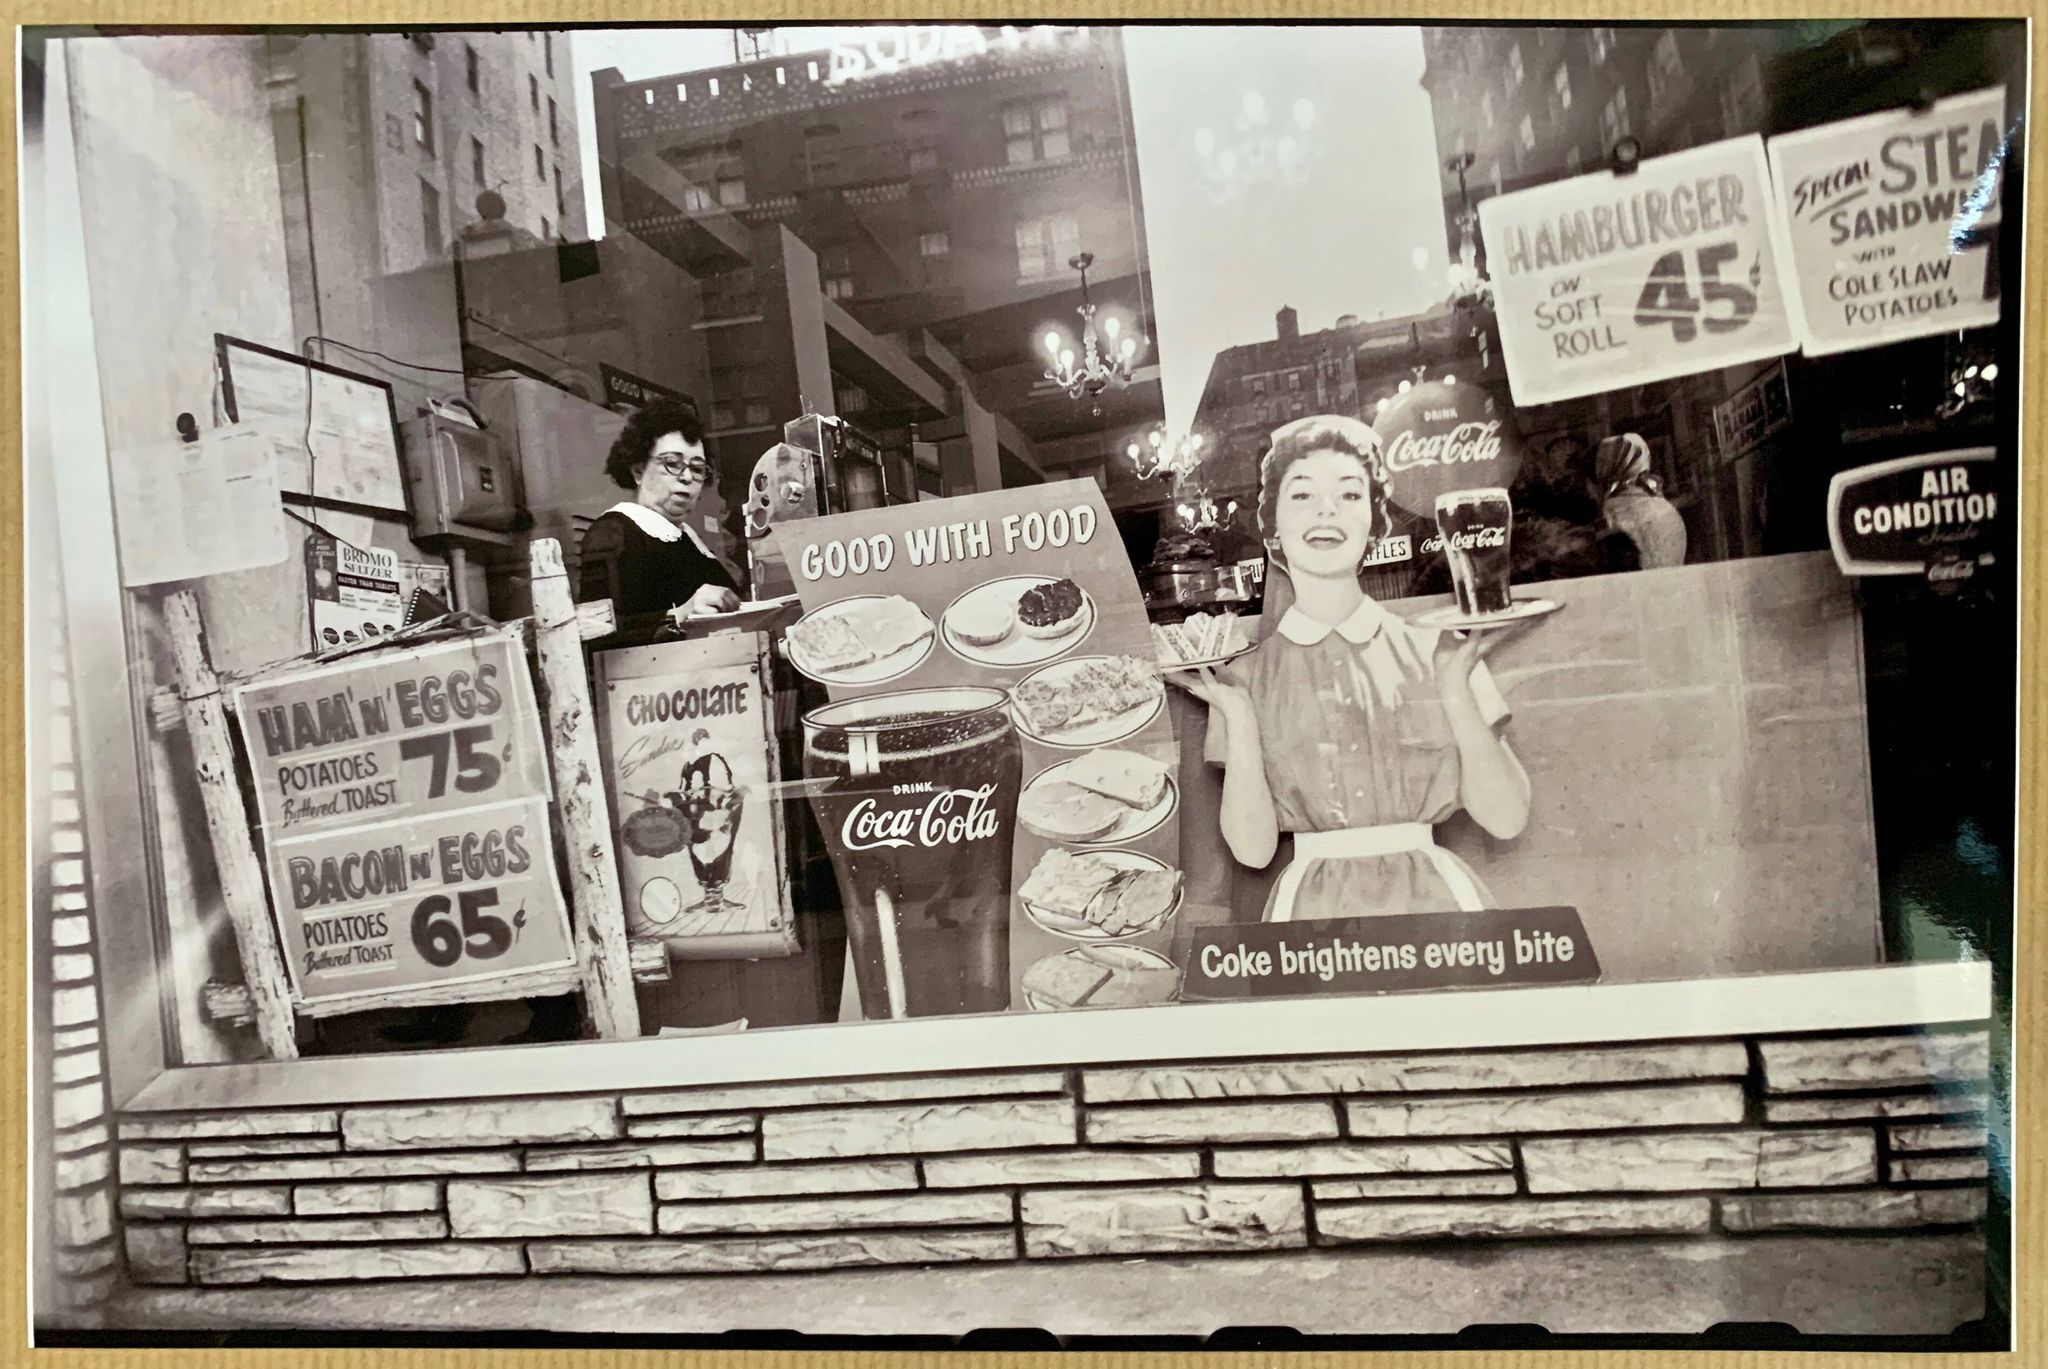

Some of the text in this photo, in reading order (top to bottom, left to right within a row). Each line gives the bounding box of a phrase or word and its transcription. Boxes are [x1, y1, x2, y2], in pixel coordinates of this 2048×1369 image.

[1503, 173, 1749, 276] HAMBURGER
[1854, 245, 1896, 265] WITH
[1550, 276, 1581, 299] ON
[1534, 294, 1602, 331] SOFT
[1844, 287, 1958, 327] POTATOES
[1553, 325, 1627, 359] ROLL
[610, 376, 640, 398] GOOD
[1423, 408, 1458, 422] DRINK
[1386, 419, 1503, 472] Coca-Cola
[1921, 466, 1970, 498] AIR
[343, 547, 392, 568] BROMO
[801, 504, 1097, 581] GOOD WITH FOOD
[343, 562, 393, 579] SELTZER
[394, 663, 503, 729] EGGS
[278, 752, 379, 796] POTATOES
[892, 781, 934, 796] DRINK
[281, 779, 398, 829] Buttered TOAST
[841, 782, 1000, 851] Coca-Cola
[287, 844, 408, 910] BACON
[438, 825, 531, 885] EGGS
[302, 912, 389, 949] POTATOES
[302, 943, 394, 976] Buttered TOAST
[1200, 928, 1575, 982] Coke brightens every bite
